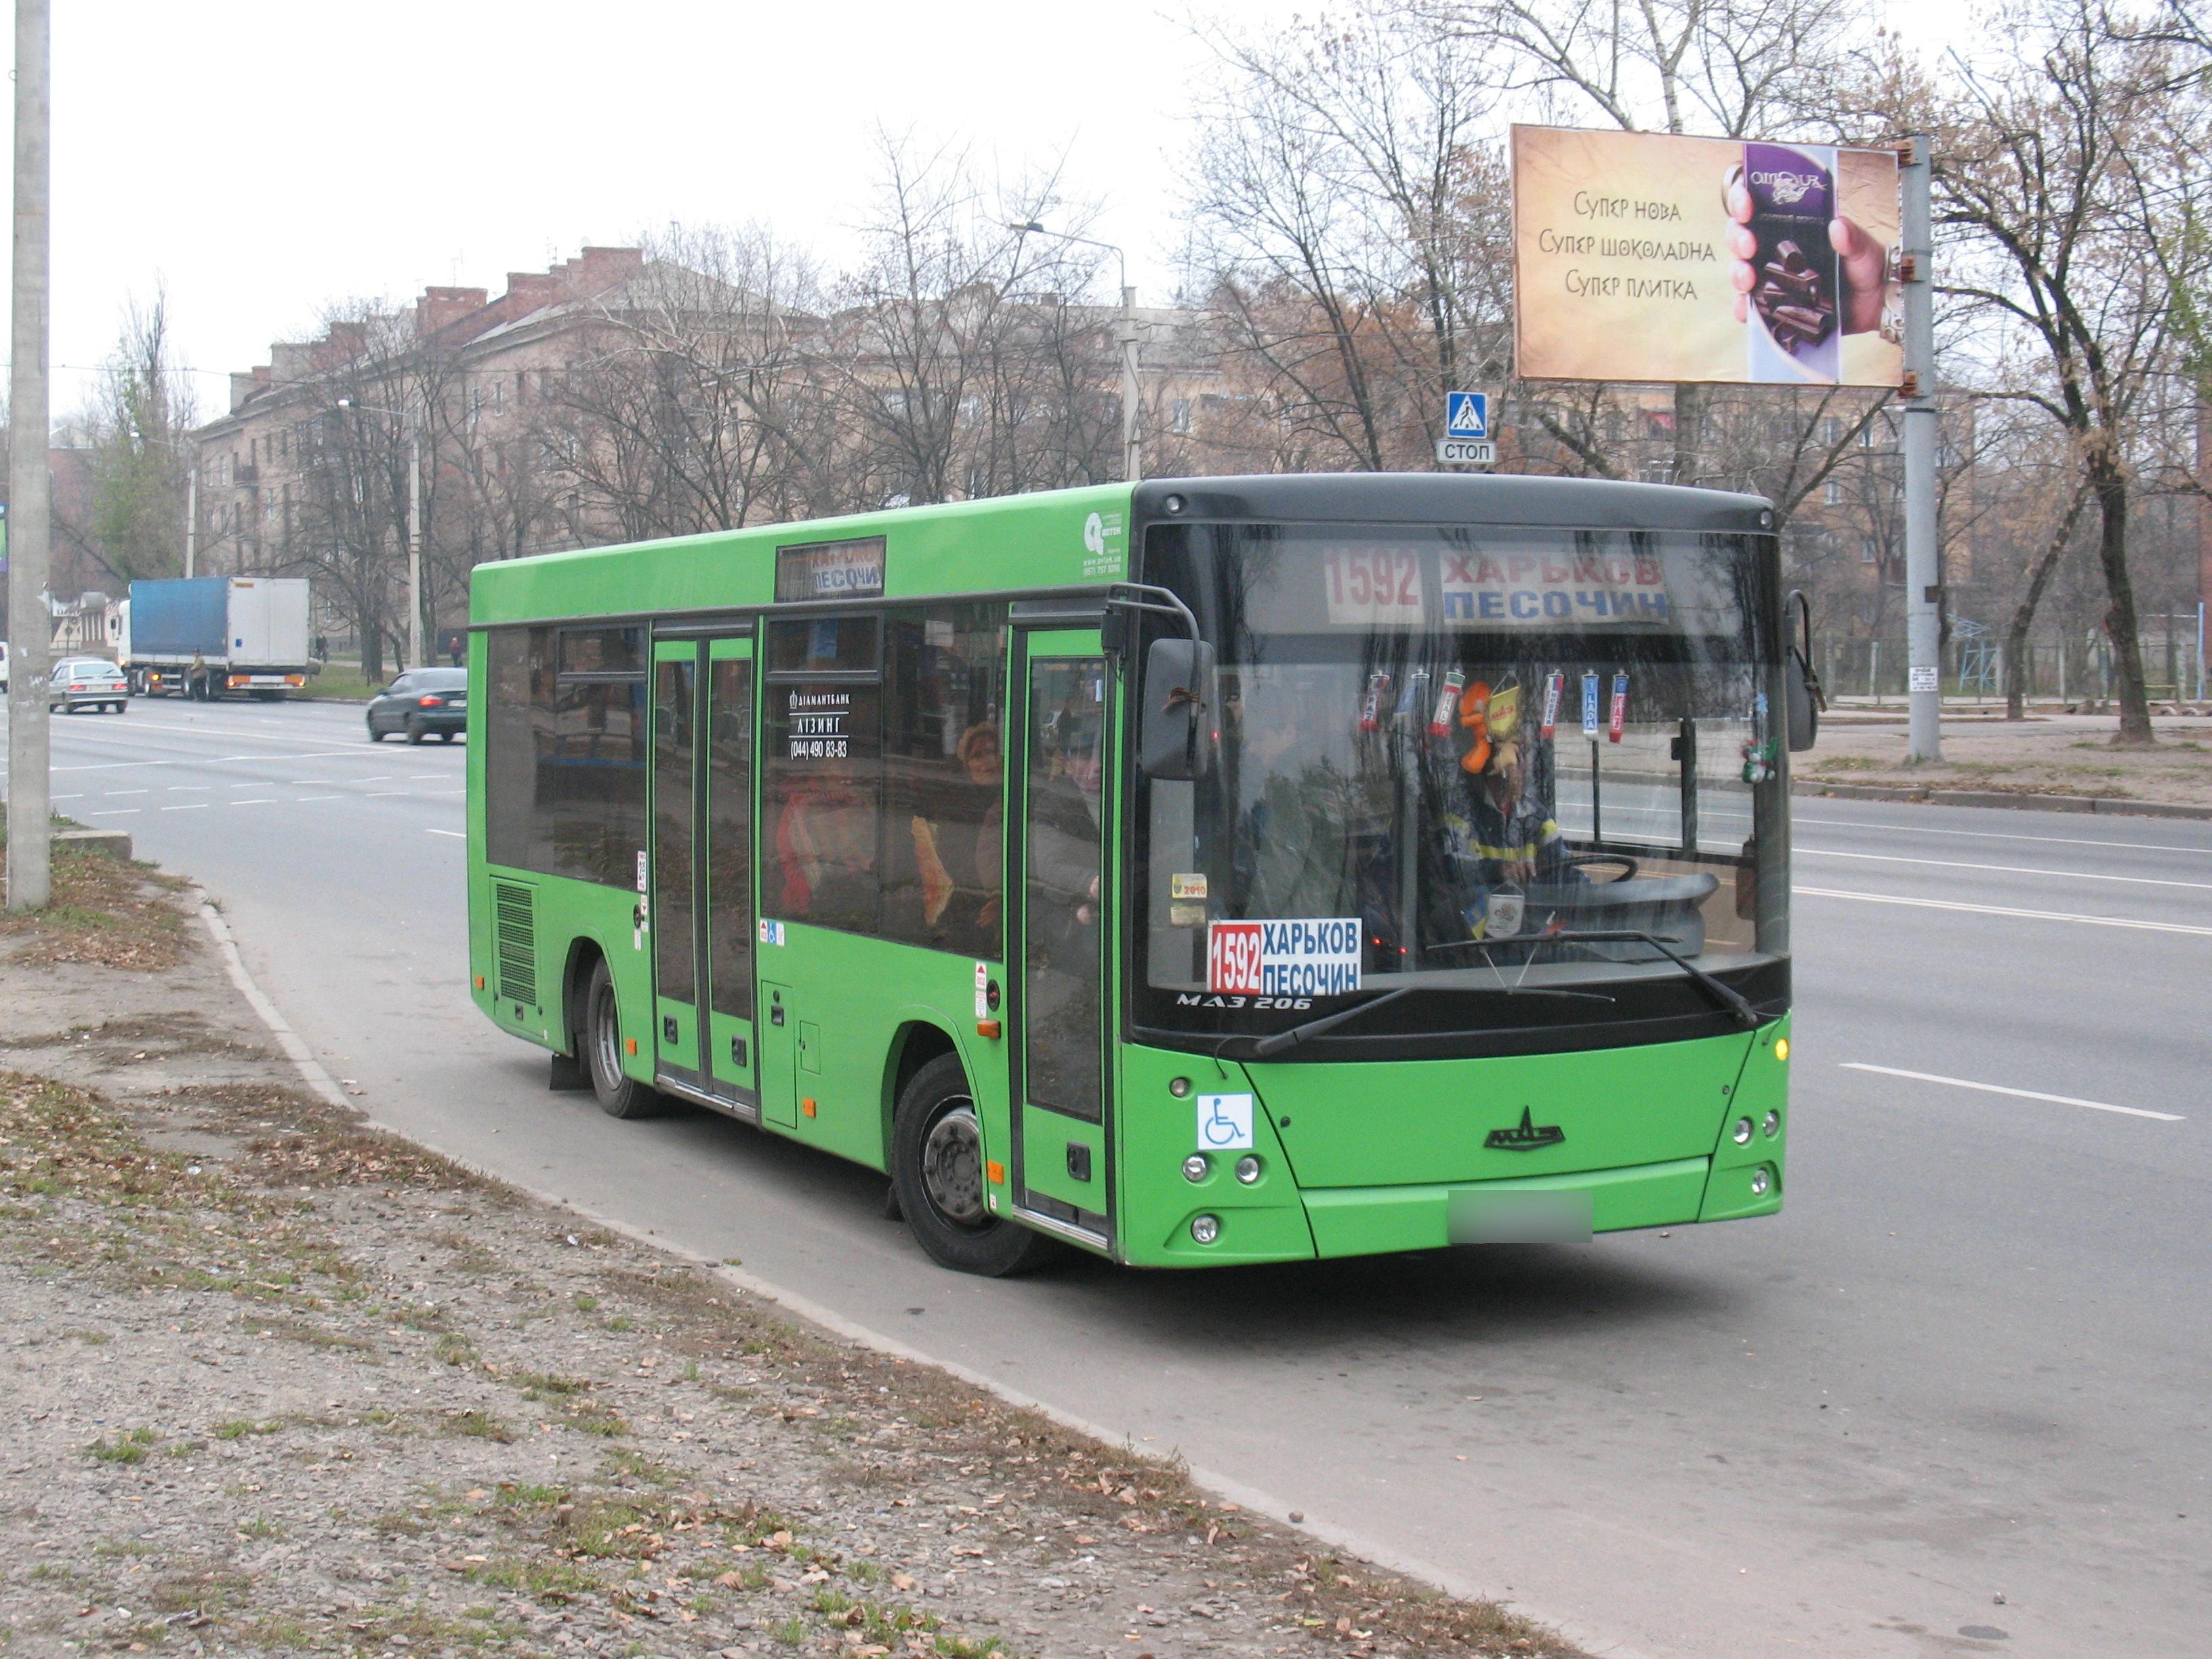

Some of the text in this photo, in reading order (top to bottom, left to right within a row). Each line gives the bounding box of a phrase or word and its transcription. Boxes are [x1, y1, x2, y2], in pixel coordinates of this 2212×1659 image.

[1445, 444, 1490, 460] СТОП
[813, 566, 880, 590] ПЕСОЧИ
[1324, 548, 1418, 606] 1592
[1444, 554, 1662, 585] ХАРЬКОВ
[1444, 591, 1668, 619] ПЕСОЧИН
[798, 694, 850, 706] ДІАМАНТБАНК
[1586, 693, 1595, 729] LADA
[797, 717, 840, 733] ЛІЗИНГ
[791, 741, 847, 760] (044) 490 83-83
[1184, 886, 1206, 895] 2010
[1213, 922, 1357, 989] 1592 ХАРЬКОВ
[1263, 963, 1357, 996] ПЕСОЧИН
[1176, 993, 1313, 1010] МАЗ 206
